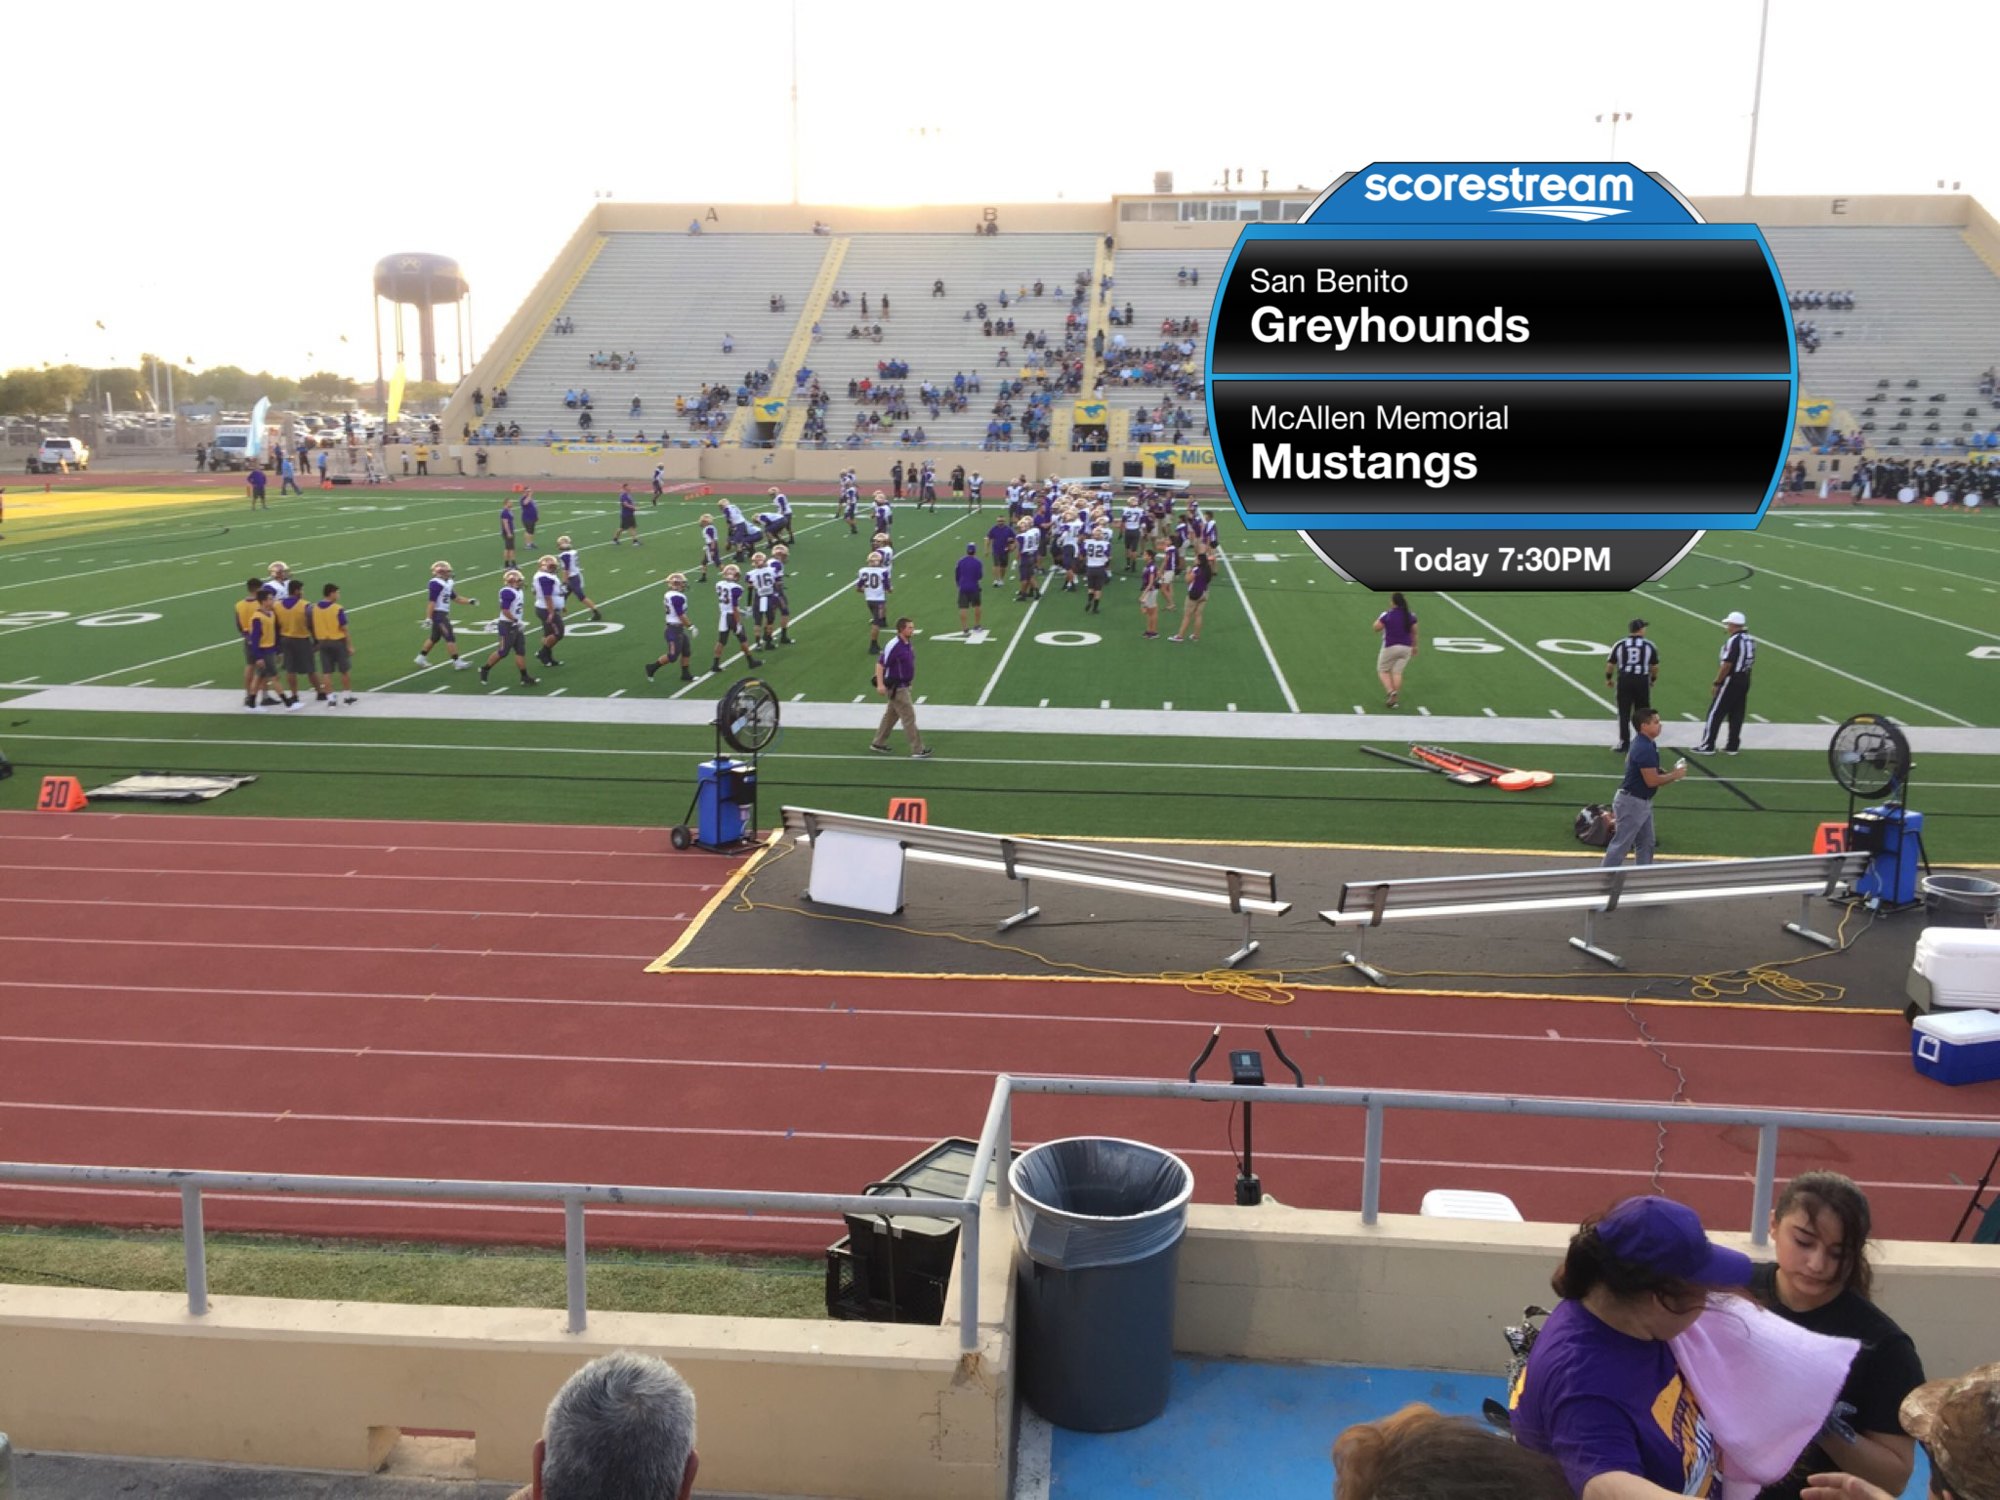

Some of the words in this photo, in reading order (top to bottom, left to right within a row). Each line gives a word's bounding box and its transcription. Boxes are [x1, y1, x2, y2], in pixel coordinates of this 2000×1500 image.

[705, 207, 719, 221] A
[983, 207, 998, 221] B
[1831, 199, 1848, 215] E
[1087, 543, 1105, 558] 92
[757, 573, 774, 588] 16
[862, 572, 879, 589] 20
[1432, 636, 1613, 656] 50
[1627, 647, 1641, 664] B
[41, 780, 71, 808] 30
